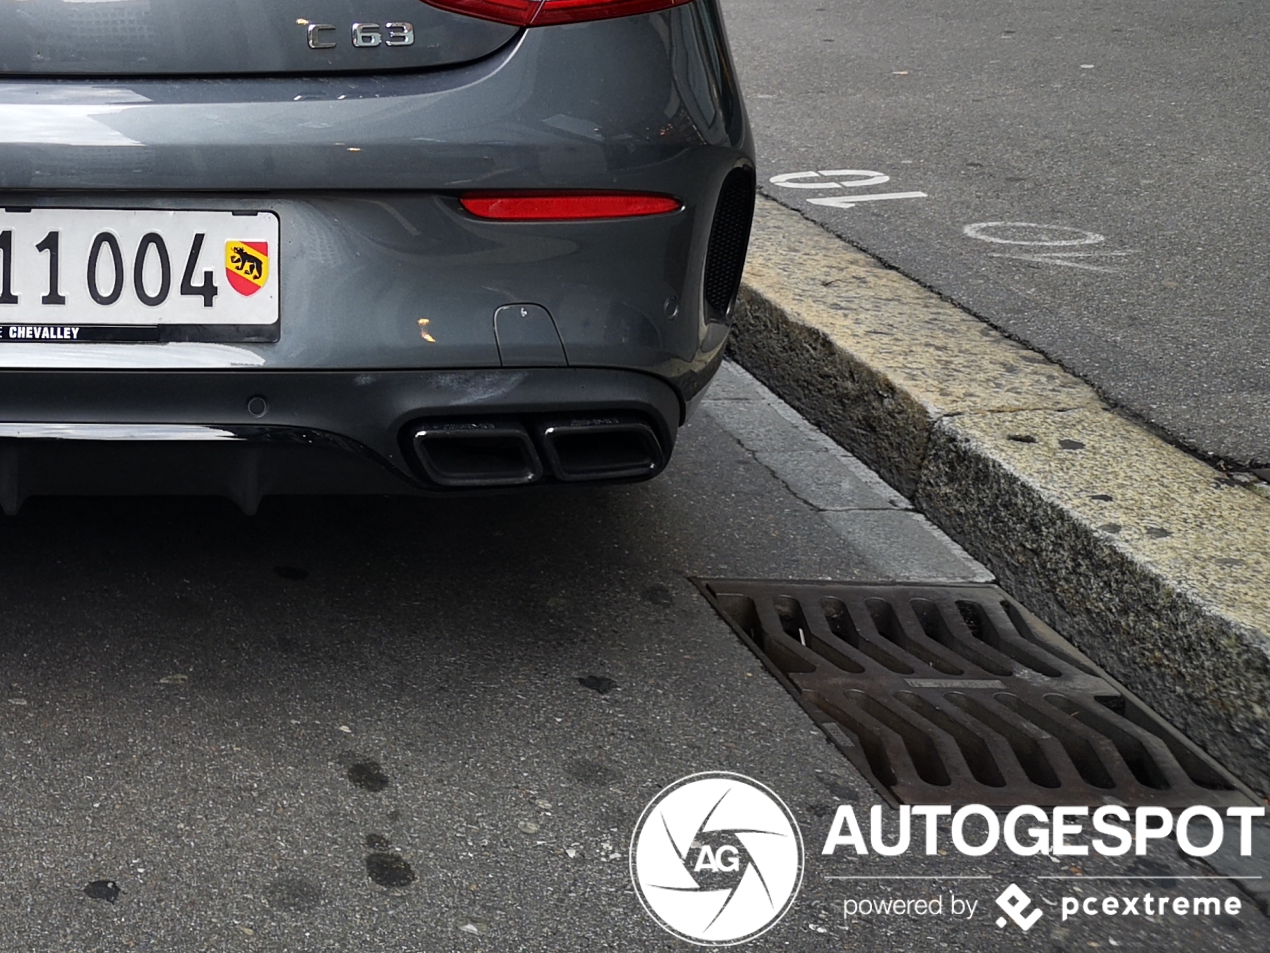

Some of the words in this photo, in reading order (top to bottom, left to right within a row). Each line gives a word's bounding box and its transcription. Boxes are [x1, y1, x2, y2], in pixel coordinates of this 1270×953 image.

[307, 23, 337, 49] C
[351, 21, 415, 48] 63
[8, 325, 80, 340] CHEVALLEY
